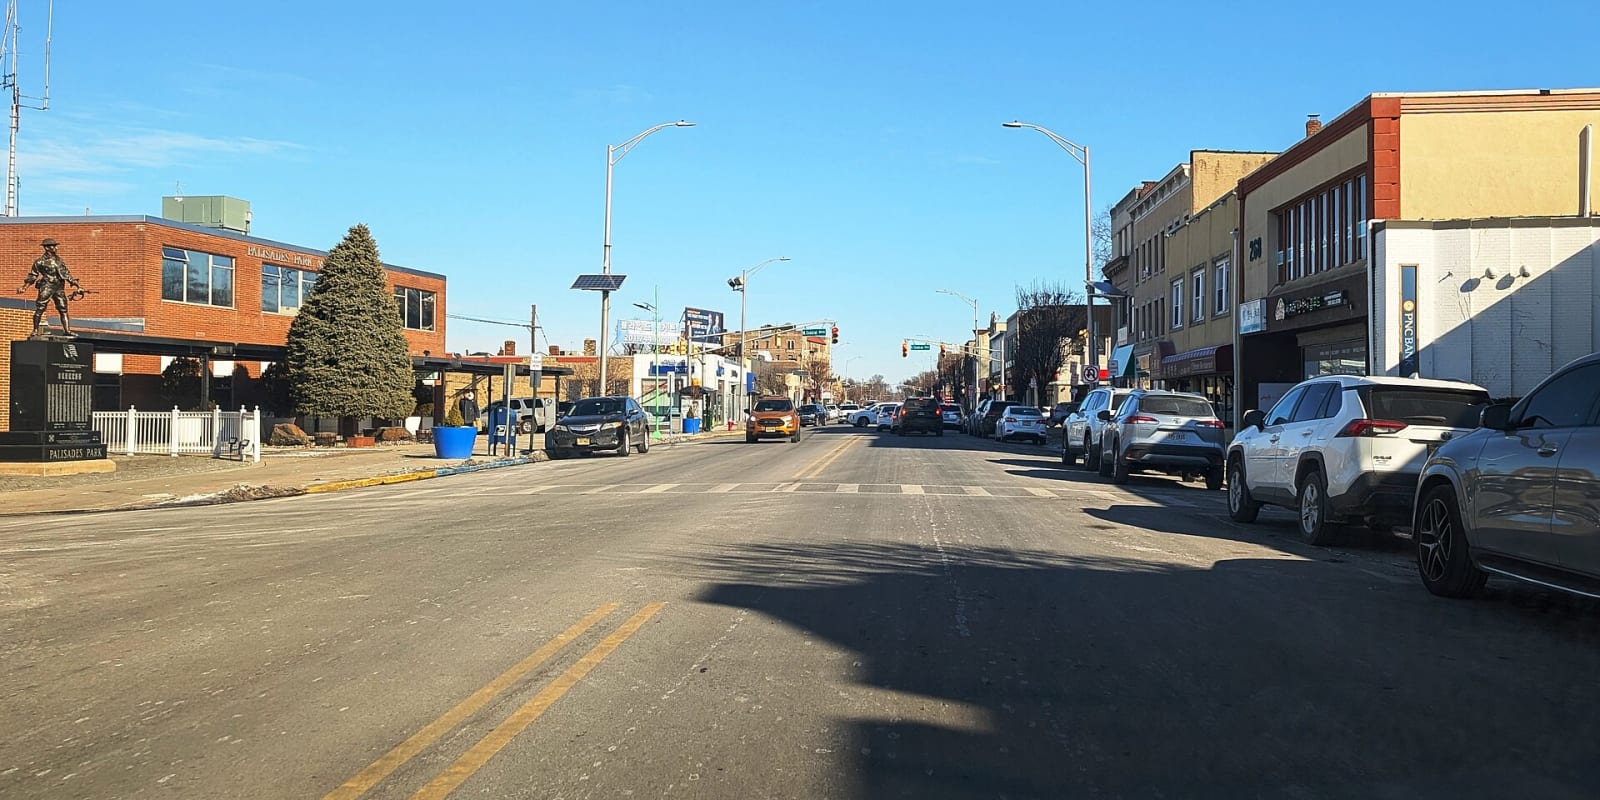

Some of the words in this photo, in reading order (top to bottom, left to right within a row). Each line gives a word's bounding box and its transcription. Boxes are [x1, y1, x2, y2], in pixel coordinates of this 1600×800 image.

[247, 246, 289, 262] PALISADES
[294, 255, 312, 266] PARK
[1404, 312, 1414, 336] PNC
[1404, 337, 1414, 366] BANK
[49, 448, 83, 459] PALISADES
[86, 447, 102, 457] PARK
